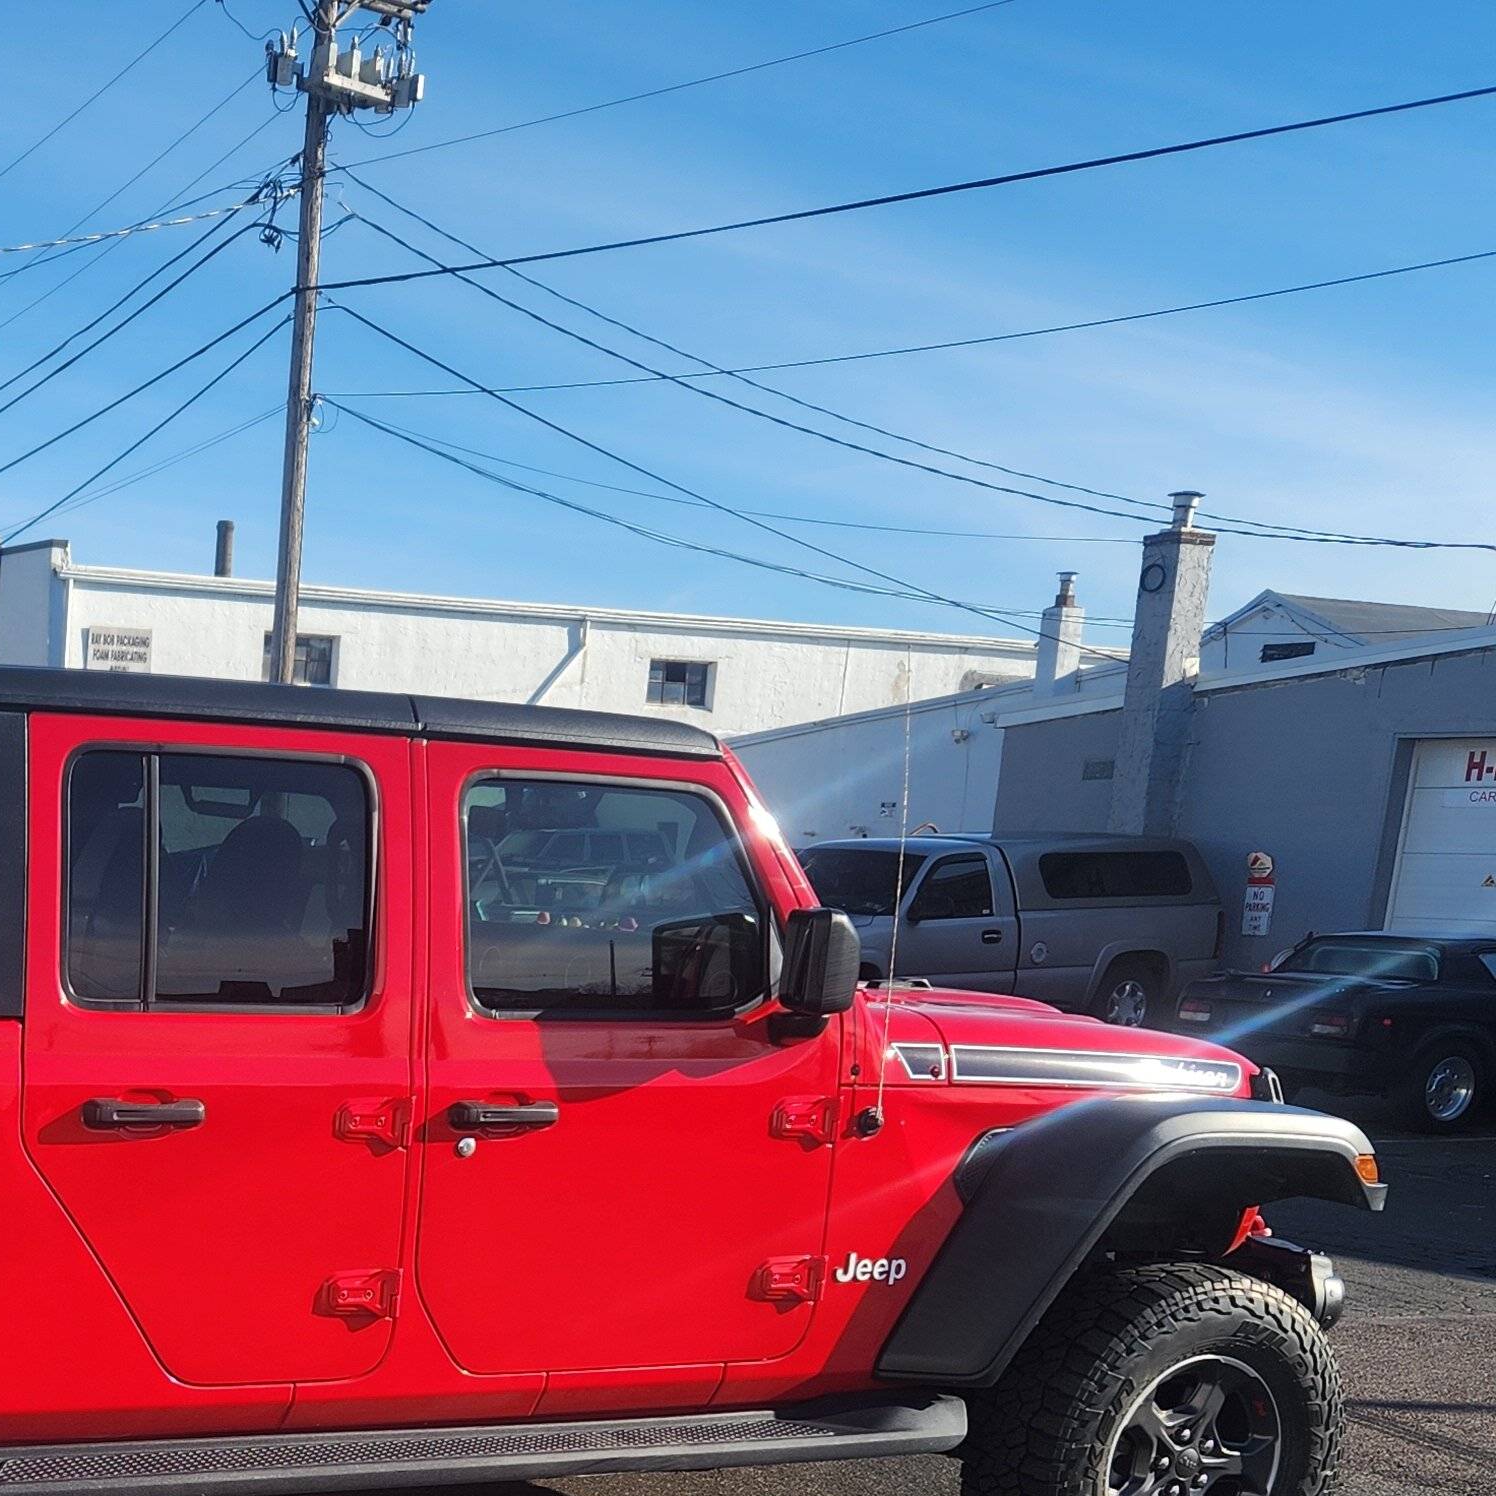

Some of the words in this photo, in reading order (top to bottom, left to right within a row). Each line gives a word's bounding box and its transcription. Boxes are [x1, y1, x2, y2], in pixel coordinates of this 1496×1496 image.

[116, 634, 150, 649] PACKAGING
[92, 648, 109, 661] FOAM
[110, 650, 148, 664] FABRICATING
[1252, 890, 1265, 901] NO
[1245, 902, 1271, 913] PARKING
[835, 1252, 906, 1285] Jeep
